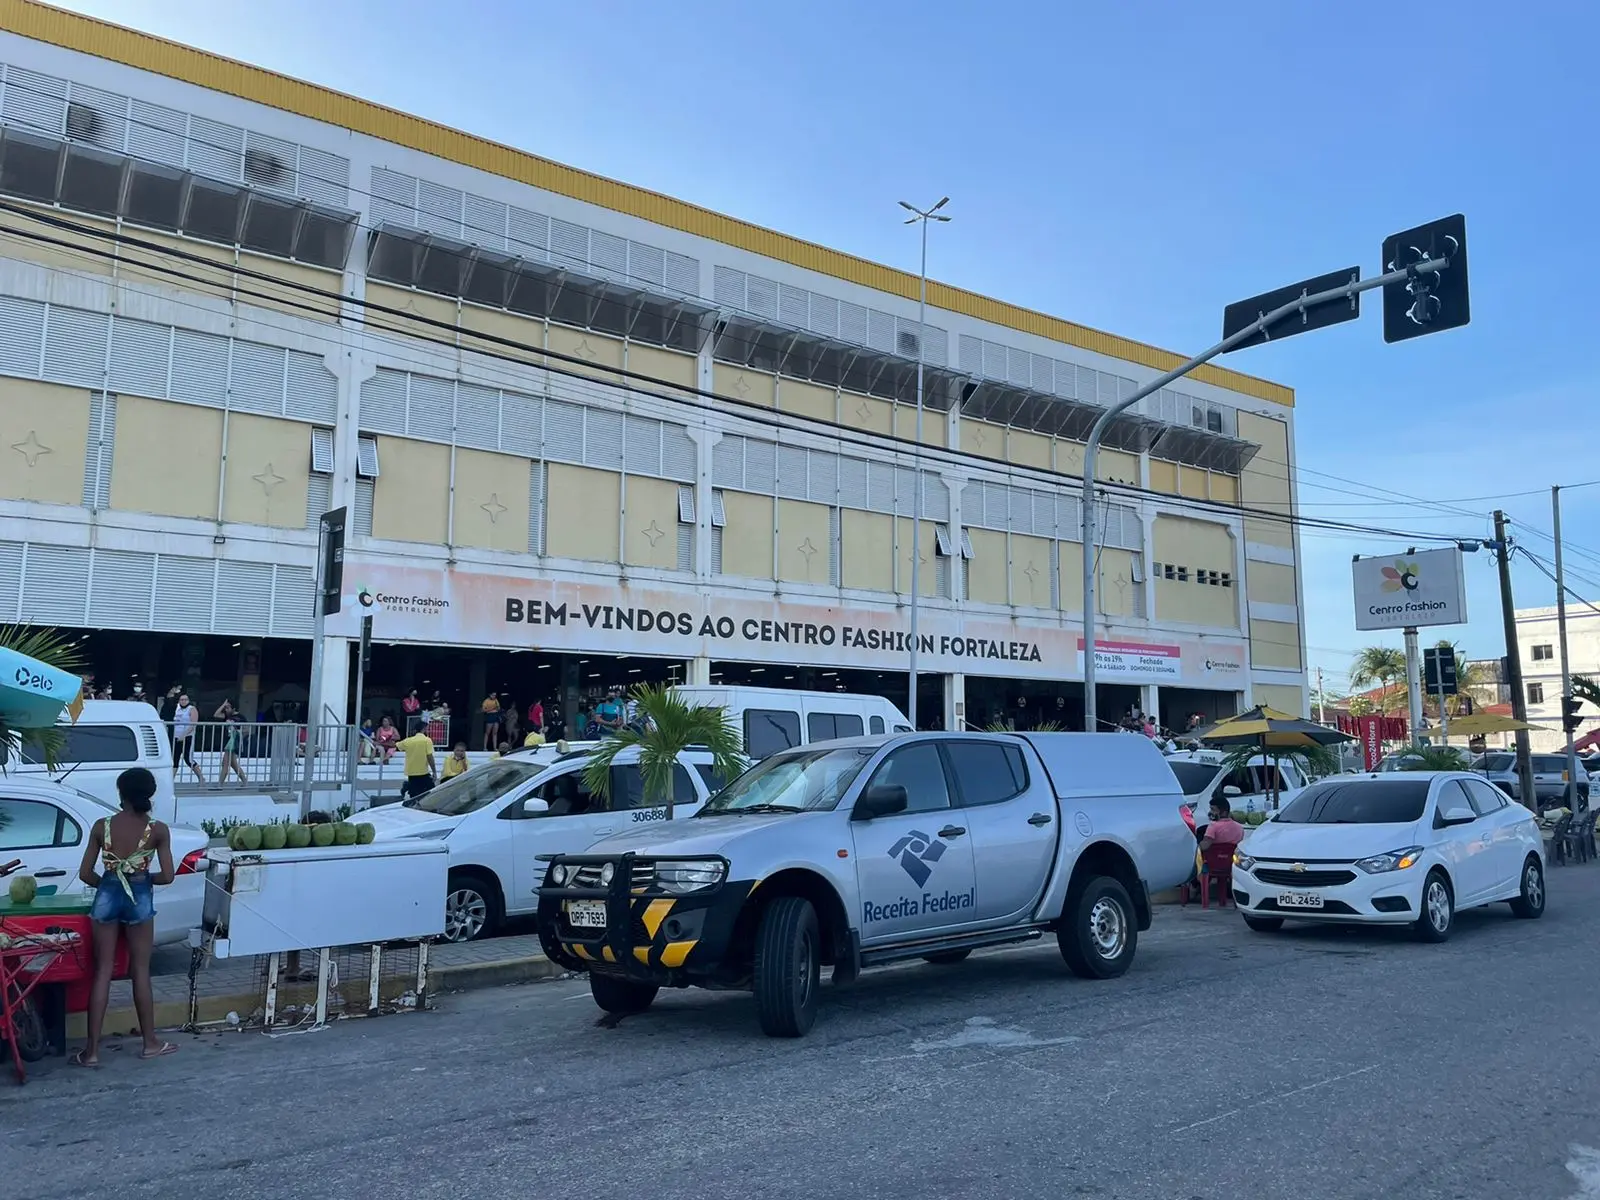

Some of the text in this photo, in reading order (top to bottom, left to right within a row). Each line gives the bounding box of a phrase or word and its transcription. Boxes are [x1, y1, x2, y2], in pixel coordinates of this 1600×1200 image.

[376, 592, 449, 608] Centro Fashion
[1369, 600, 1447, 616] Centro Fashion
[505, 597, 1042, 662] BEM-VINDOS AO CENTRO FASHION FORTALEZA
[631, 809, 667, 823] 30688
[863, 887, 975, 924] Receita Federal
